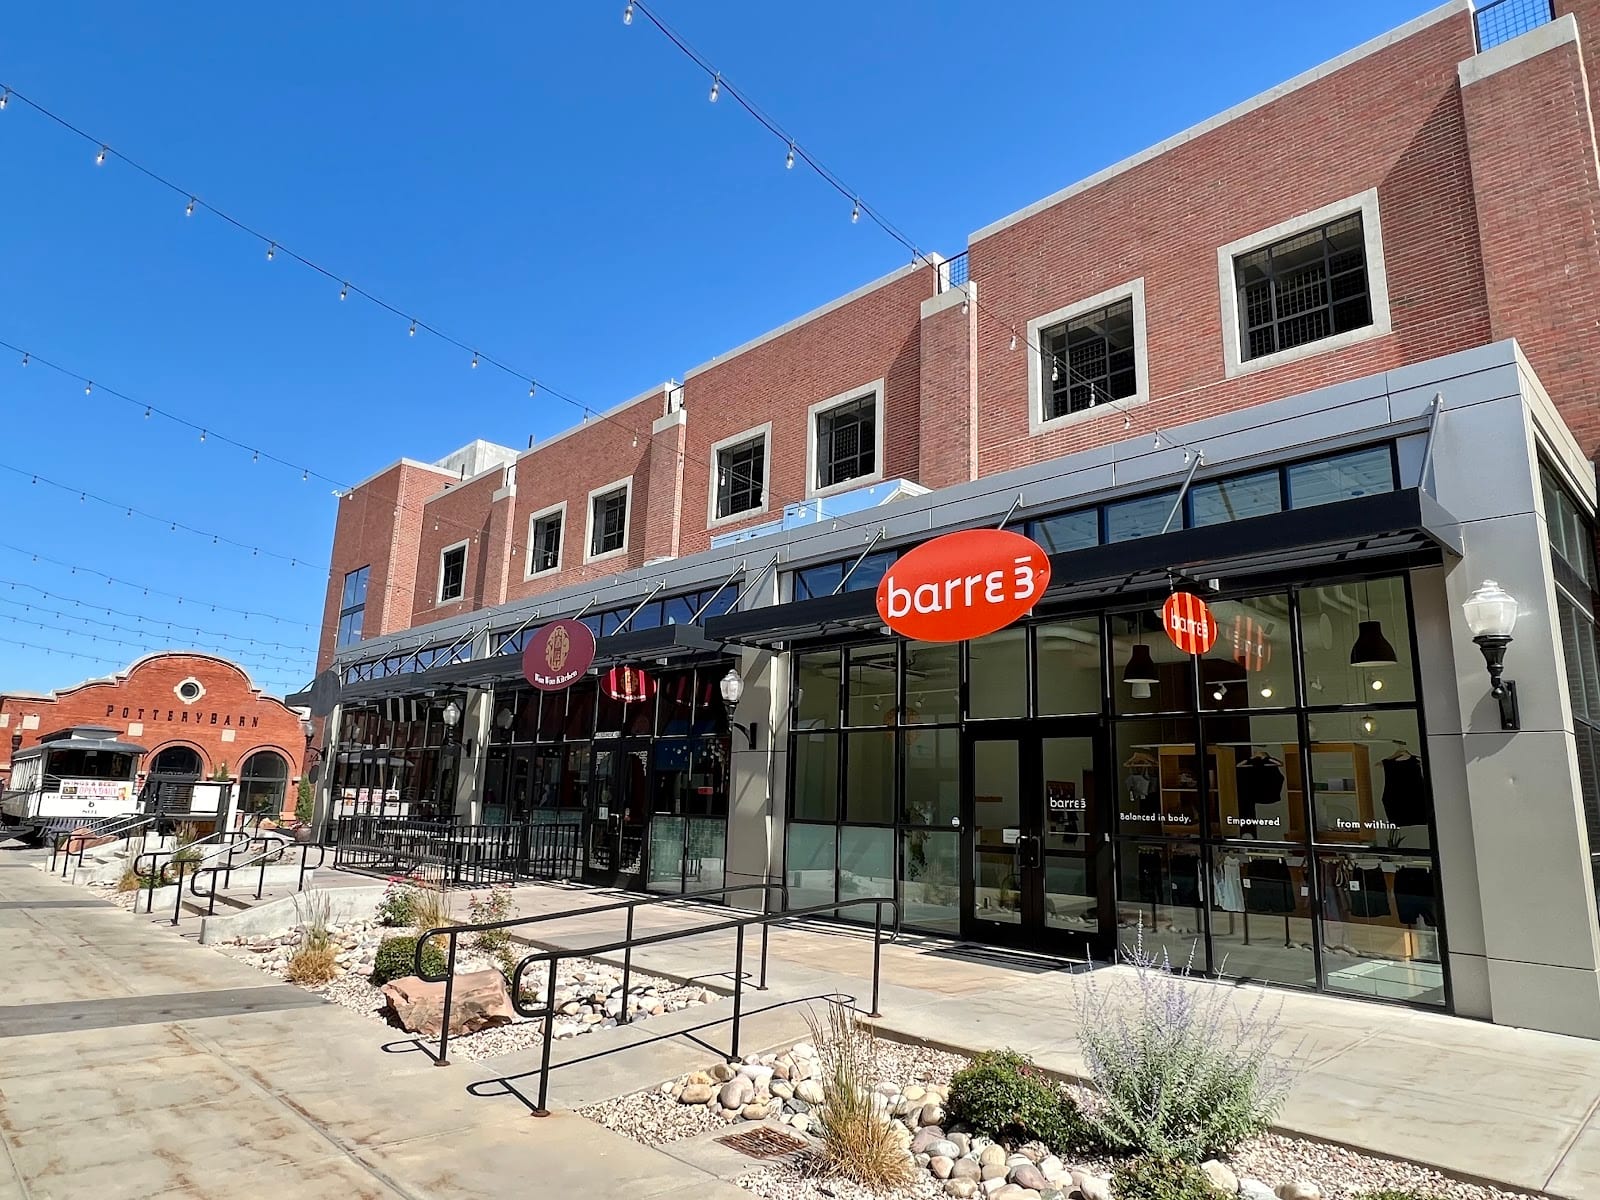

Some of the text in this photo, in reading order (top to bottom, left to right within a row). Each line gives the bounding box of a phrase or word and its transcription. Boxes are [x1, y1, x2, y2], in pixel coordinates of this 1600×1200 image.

[1119, 812, 1192, 825] Balanced in body.
[1226, 816, 1281, 827] Empowered
[1336, 818, 1361, 829] from
